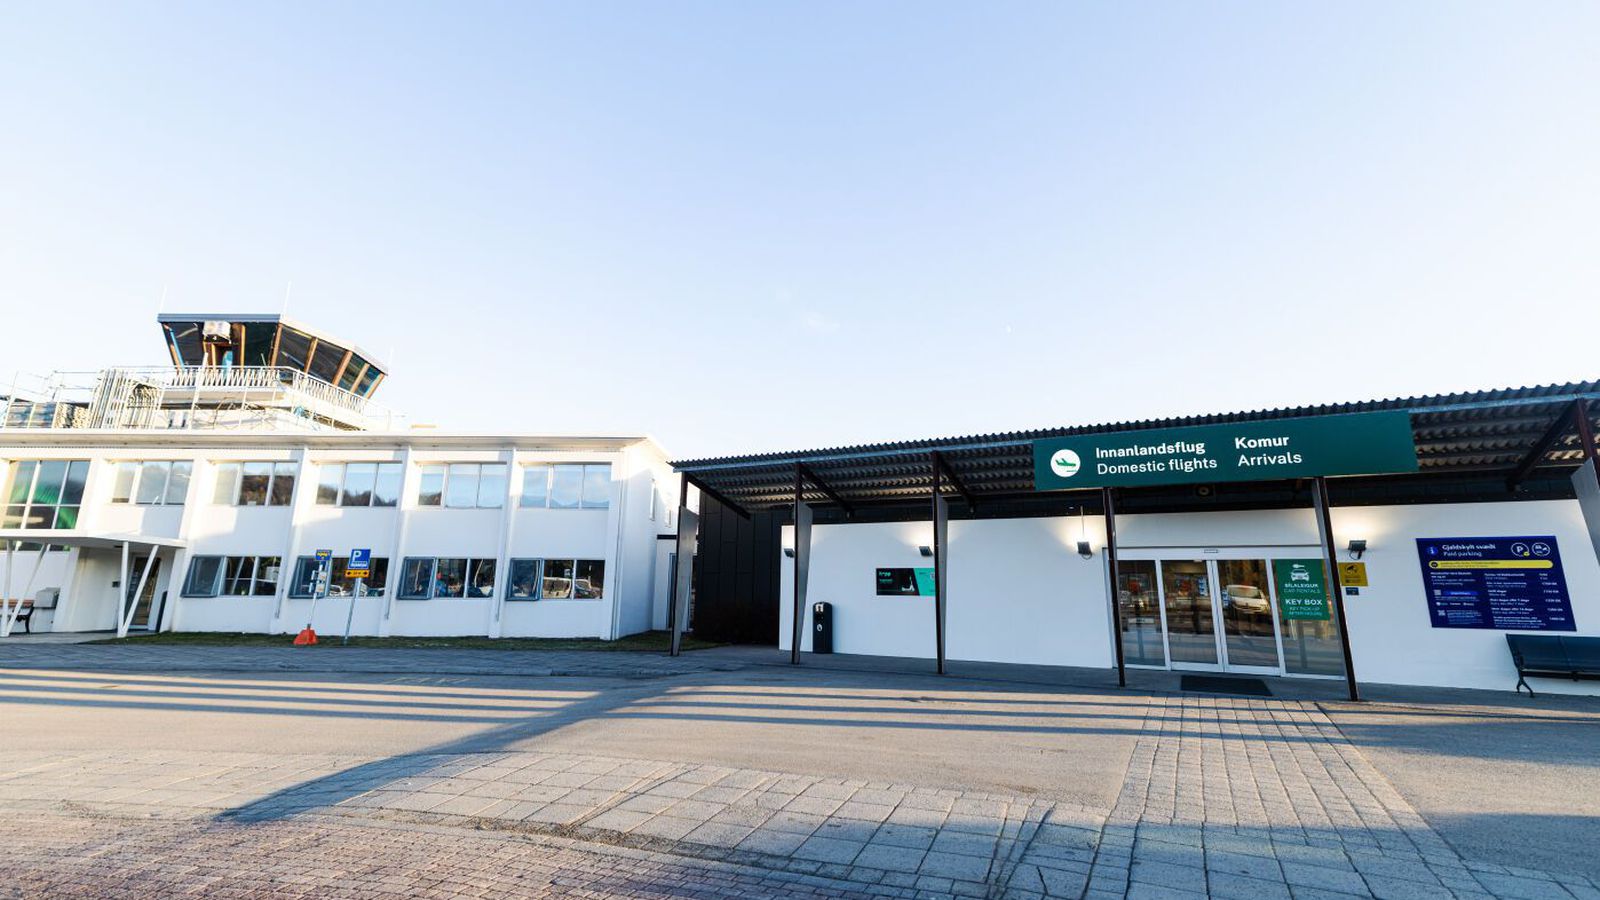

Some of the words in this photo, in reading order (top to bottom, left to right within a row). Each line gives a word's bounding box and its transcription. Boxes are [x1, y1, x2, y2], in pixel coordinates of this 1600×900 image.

[1096, 442, 1205, 459] Innanlandsflug
[1235, 437, 1290, 450] Komur
[1097, 459, 1165, 475] Domestic
[1169, 456, 1218, 473] flights
[1238, 451, 1302, 467] Arrivals
[353, 550, 361, 561] P
[1304, 598, 1323, 606] BOX
